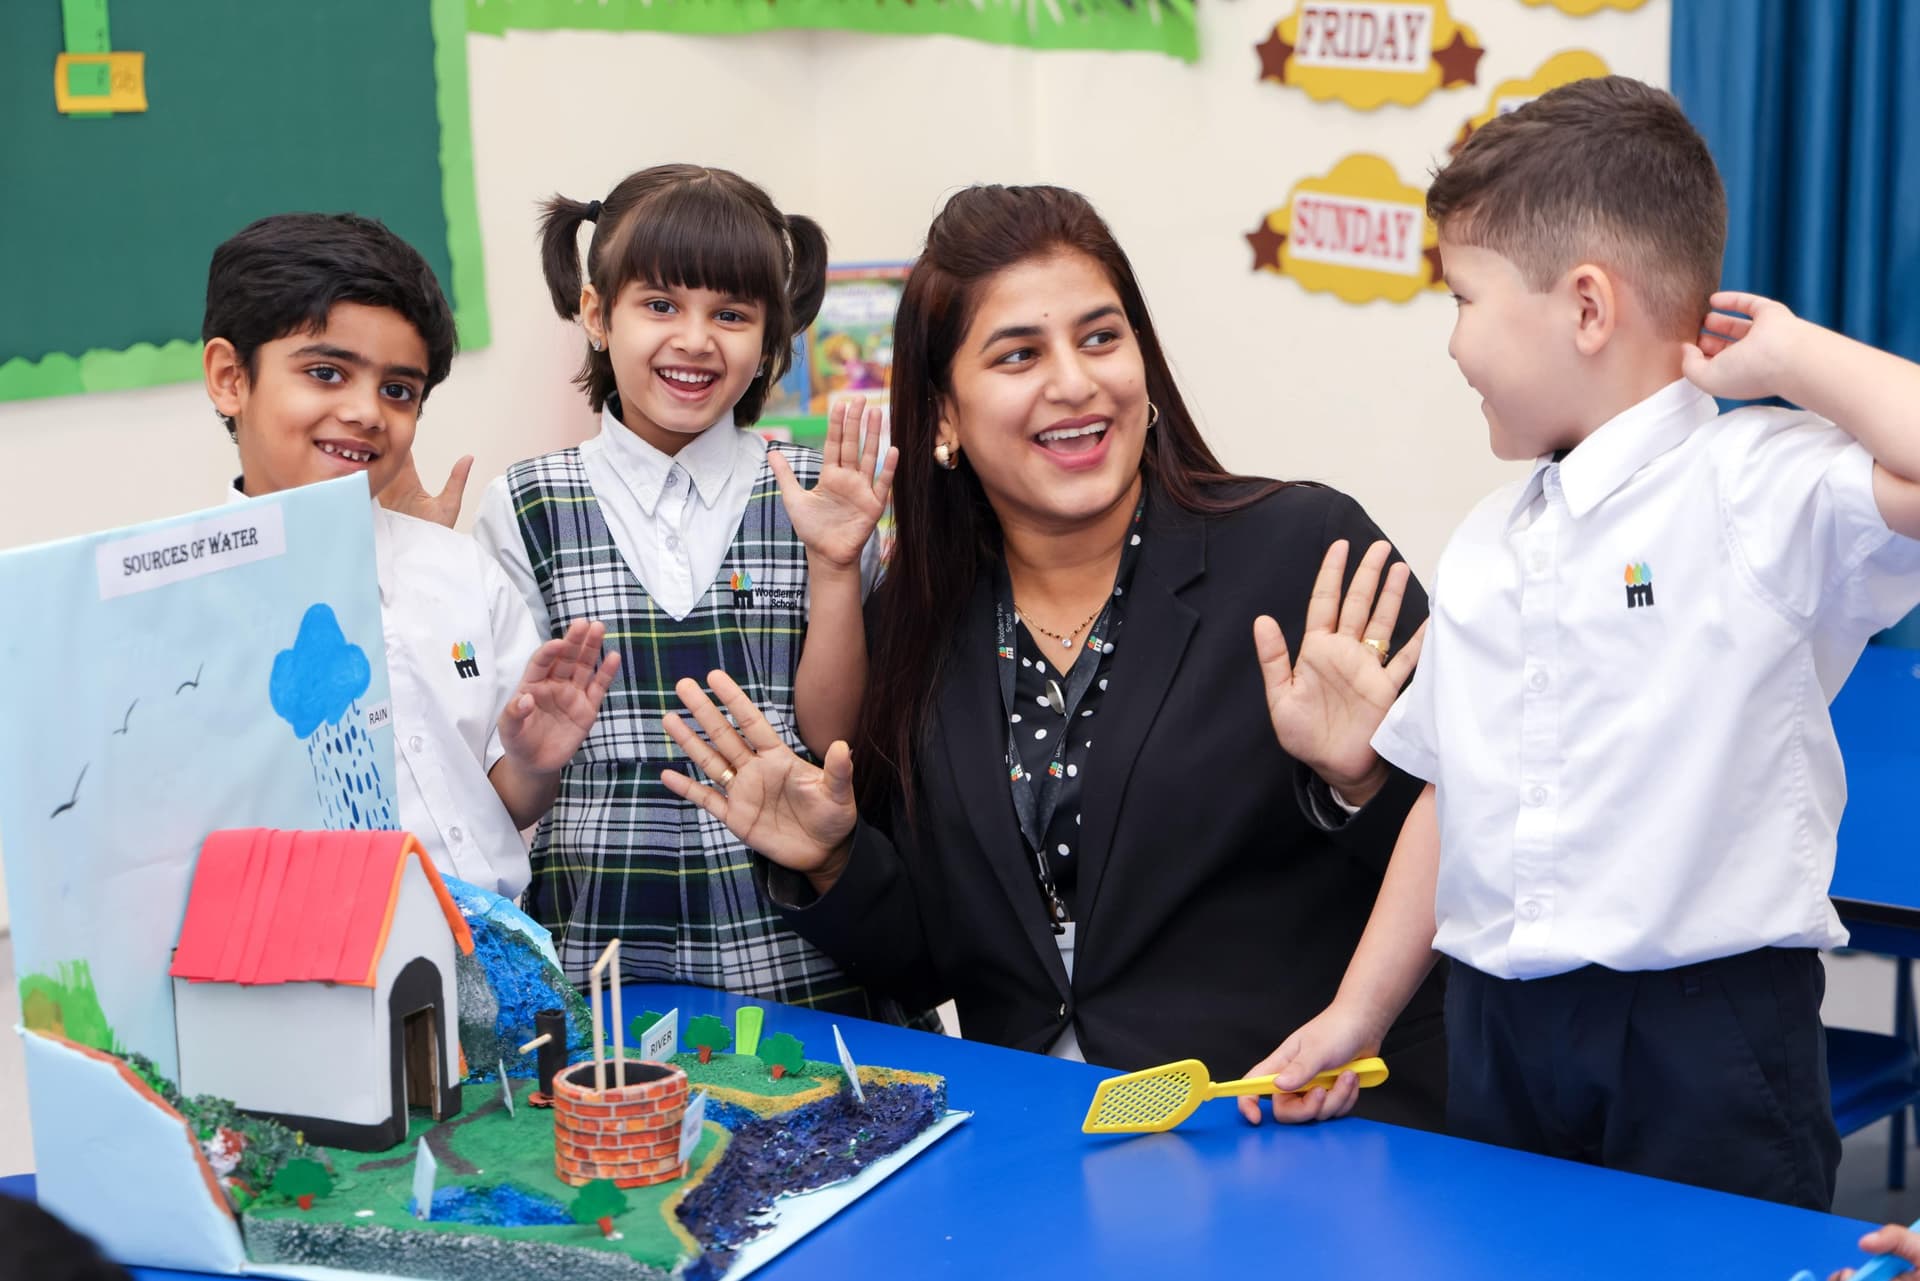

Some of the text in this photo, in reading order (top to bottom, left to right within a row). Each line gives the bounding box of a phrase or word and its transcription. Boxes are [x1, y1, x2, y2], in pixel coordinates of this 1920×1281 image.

[1295, 9, 1425, 61] FRIDAY
[1295, 199, 1414, 261] SUNDAY
[122, 527, 259, 576] SOURCES OF WATER
[770, 599, 798, 610] School
[369, 707, 388, 725] RAIN
[650, 1029, 673, 1057] RIVER
